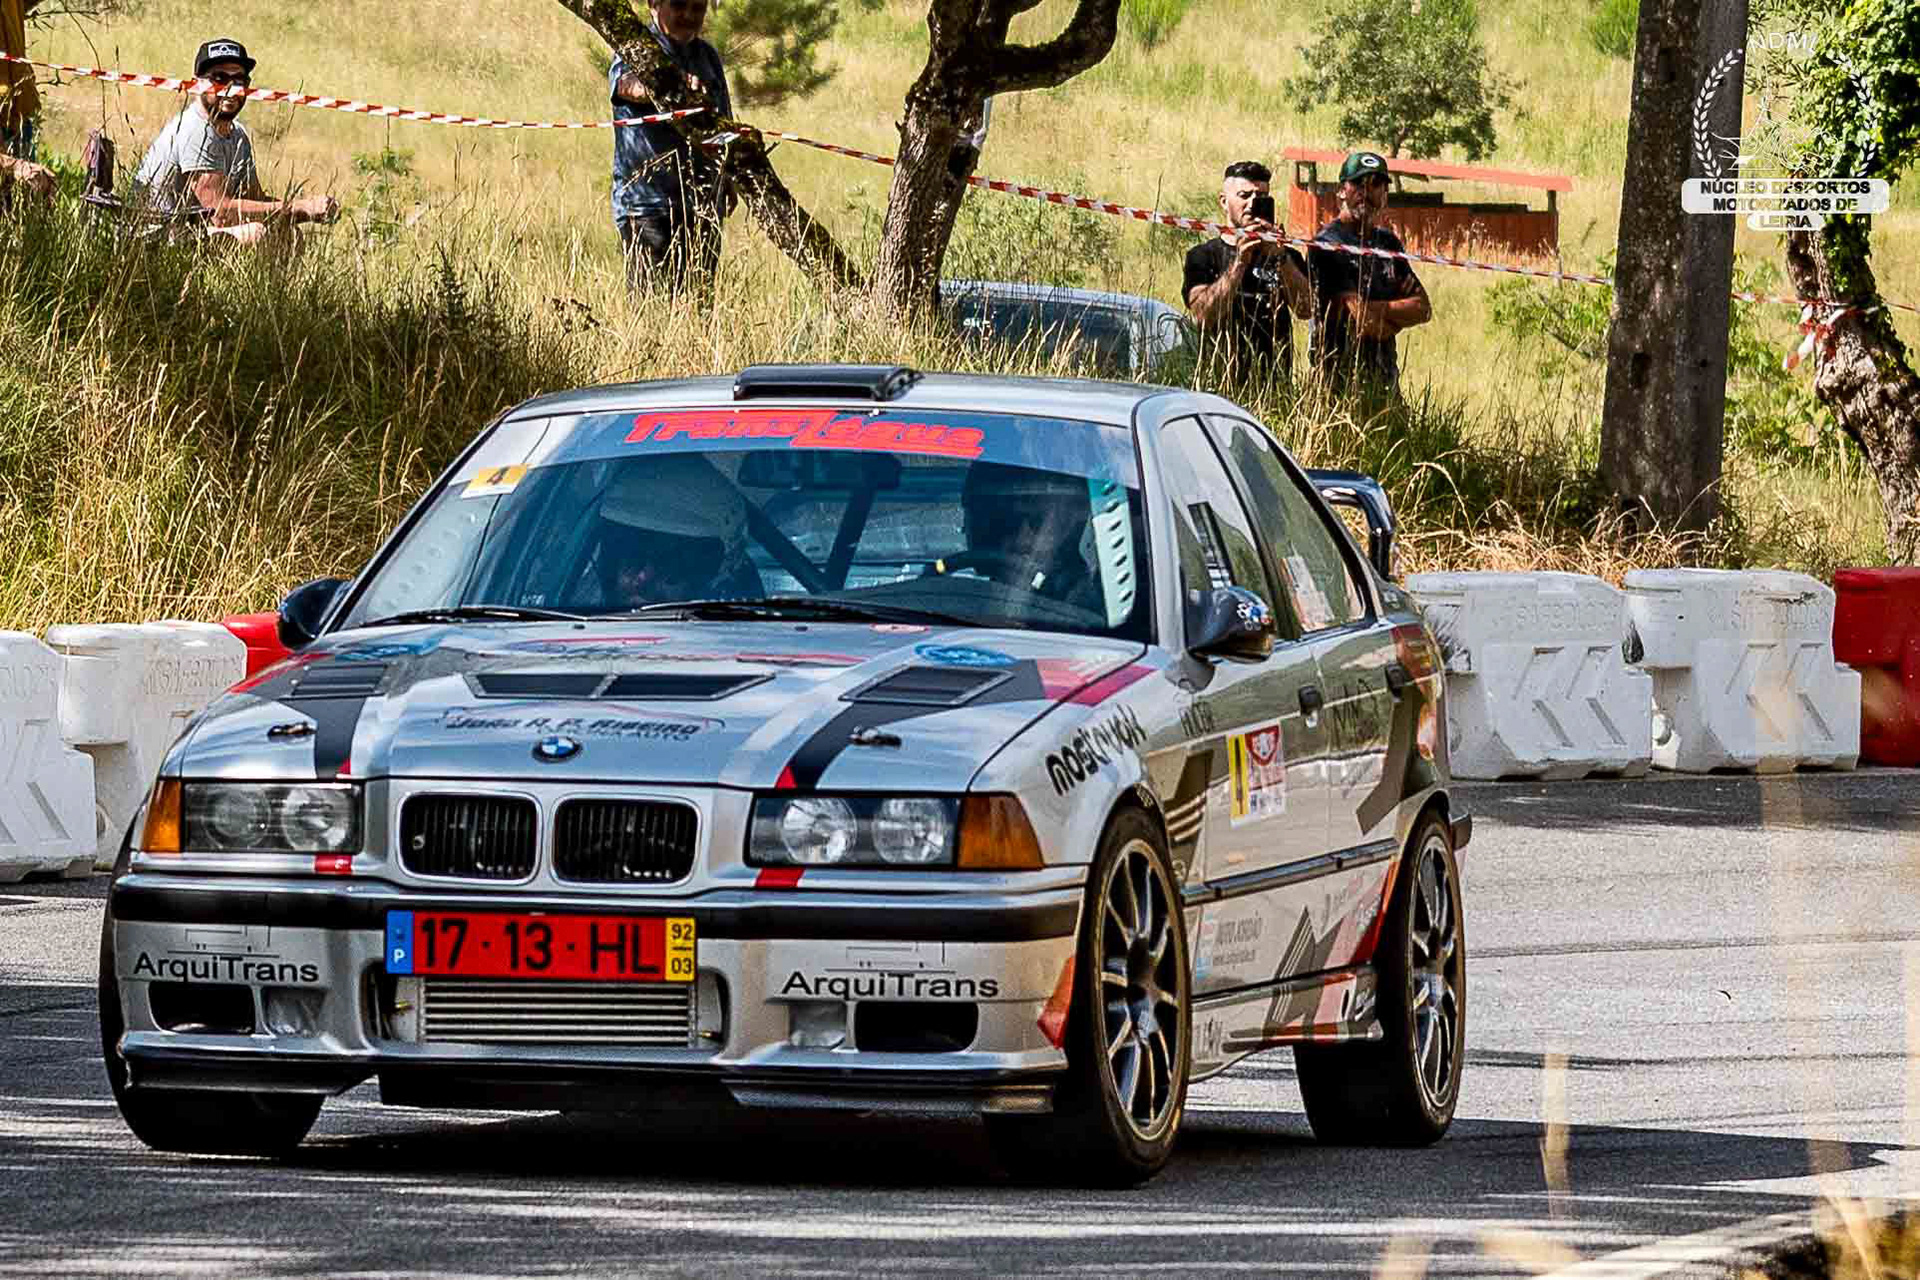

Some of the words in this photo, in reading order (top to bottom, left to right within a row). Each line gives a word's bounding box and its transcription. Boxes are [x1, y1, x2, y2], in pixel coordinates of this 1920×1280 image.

[671, 923, 693, 942] 92
[393, 948, 405, 963] P
[133, 951, 320, 983] ArquiTrans
[671, 956, 693, 975] 03
[781, 970, 999, 1000] ArquiTrans
